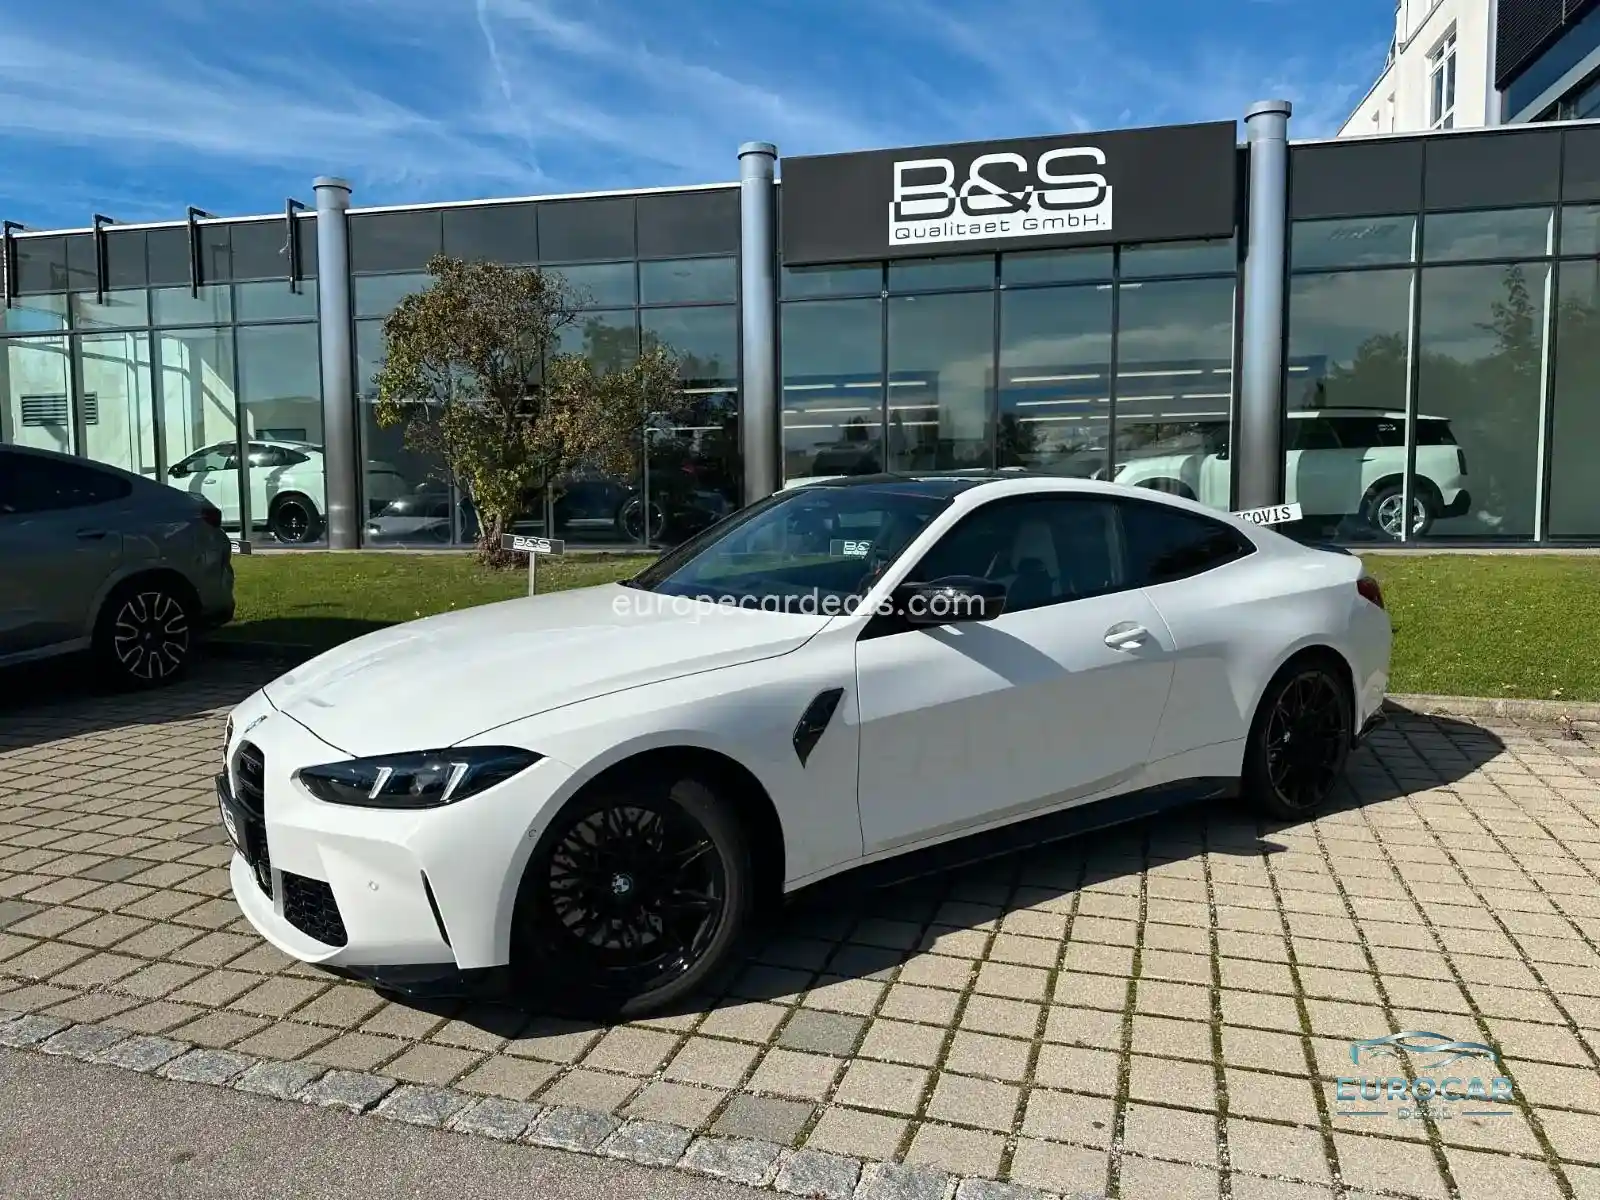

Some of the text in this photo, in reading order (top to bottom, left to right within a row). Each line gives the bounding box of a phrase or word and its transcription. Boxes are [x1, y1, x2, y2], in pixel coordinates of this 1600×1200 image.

[893, 146, 1107, 222] B&S
[894, 212, 1107, 240] Qualitaet GmbH.
[1235, 506, 1291, 525] COVIS
[513, 536, 551, 549] B&S
[843, 541, 870, 552] B&
